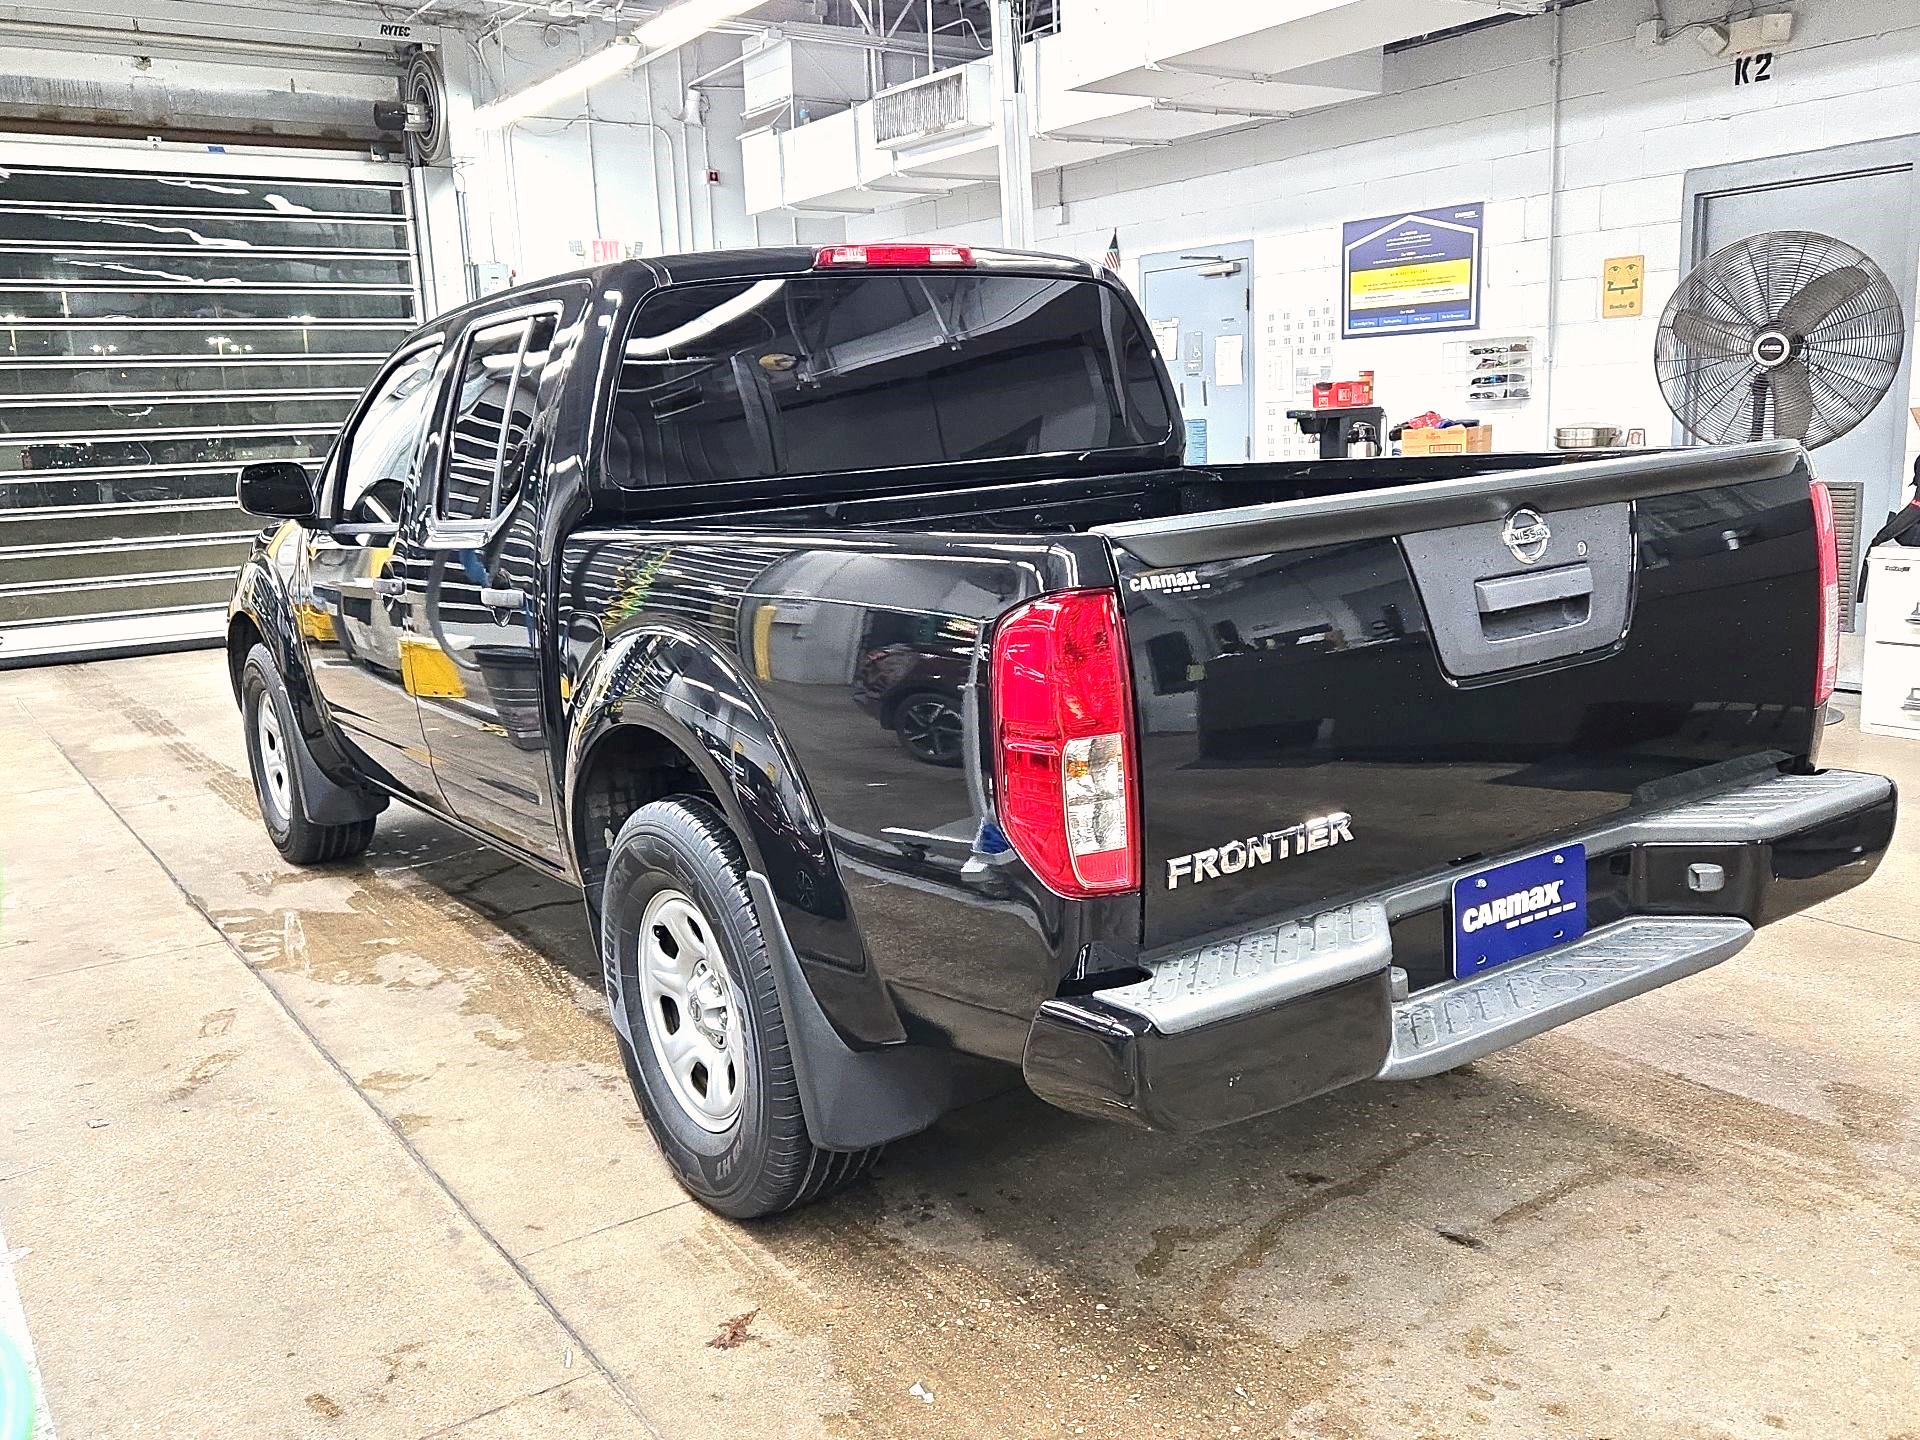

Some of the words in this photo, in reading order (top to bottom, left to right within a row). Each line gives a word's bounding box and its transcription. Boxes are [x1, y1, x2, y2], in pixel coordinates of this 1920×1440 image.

[380, 24, 411, 37] RYTEC
[1735, 53, 1772, 85] K2
[592, 240, 620, 263] EXIT
[1166, 812, 1354, 890] FRONTIER
